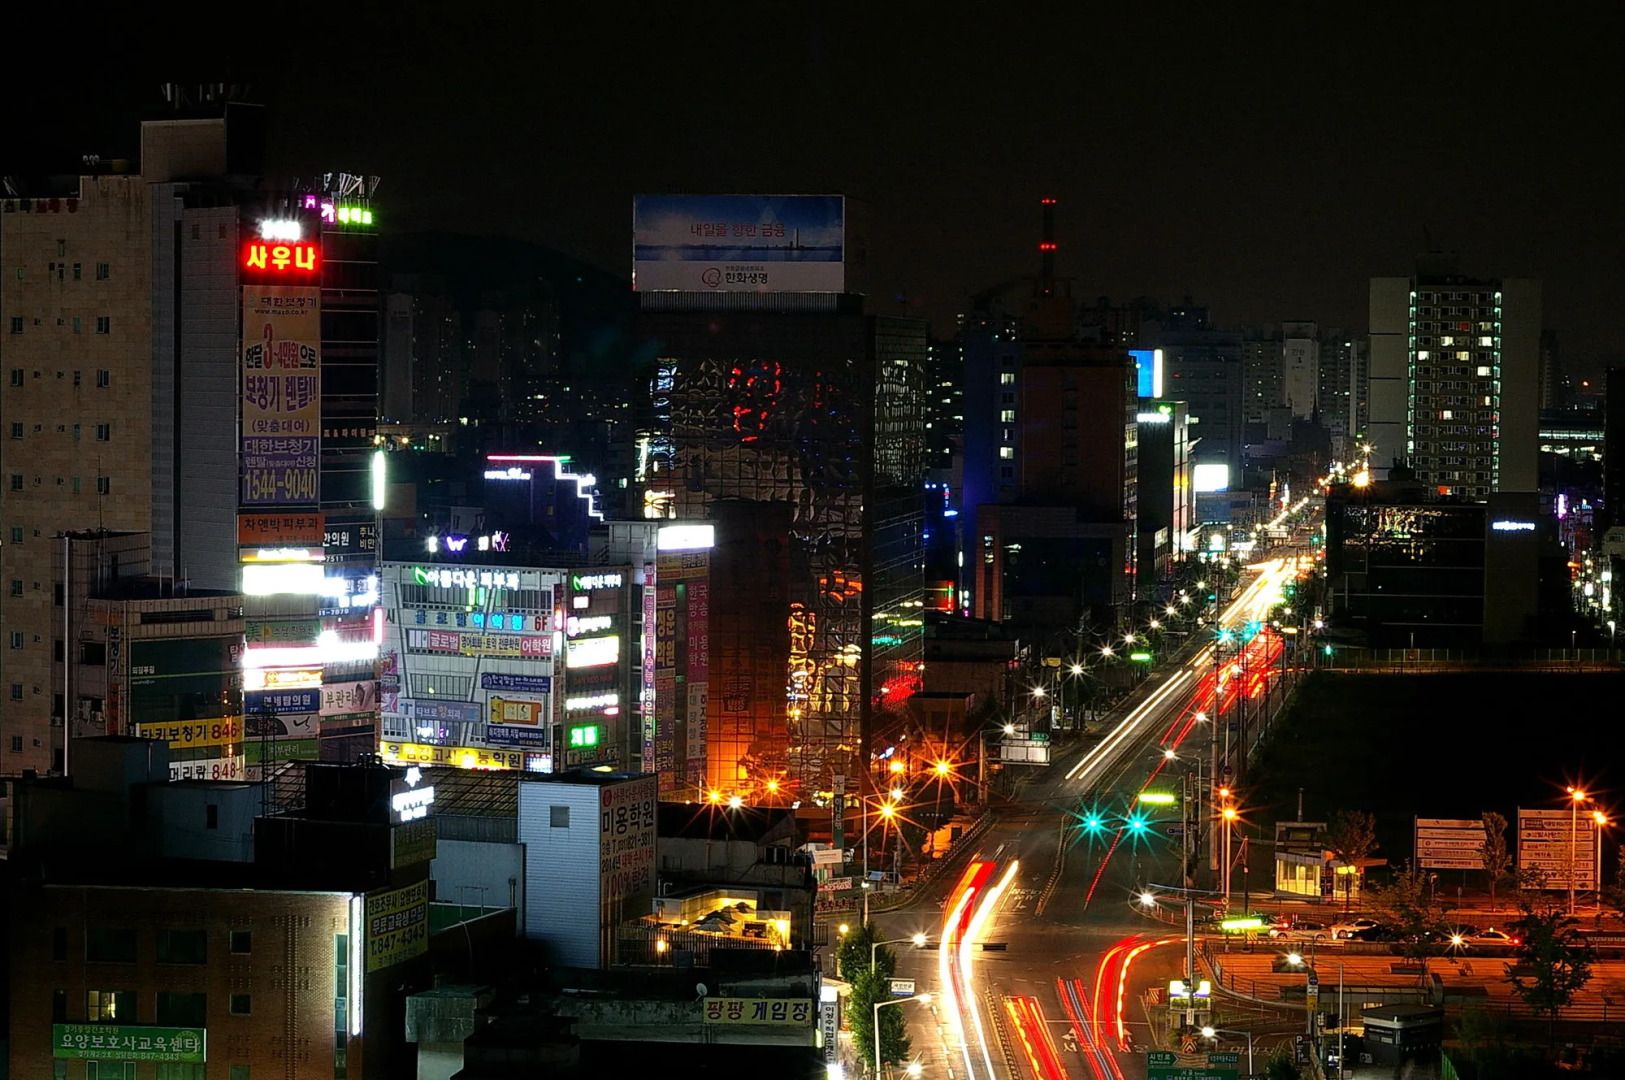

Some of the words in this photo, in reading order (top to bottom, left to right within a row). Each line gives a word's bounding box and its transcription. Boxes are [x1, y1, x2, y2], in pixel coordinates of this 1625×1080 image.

[690, 224, 728, 237] 내일을
[732, 224, 757, 237] 향한
[761, 224, 786, 237] 금융
[247, 245, 316, 270] 사우나
[725, 272, 768, 285] 한화생명
[261, 297, 317, 308] 대한보청기
[245, 376, 280, 412] 보청기
[285, 376, 317, 412] 렌탈!!
[252, 419, 310, 433] (맞춤대여)
[244, 438, 317, 455] 대한보청기
[244, 469, 317, 500] 1544-9040
[534, 616, 548, 631] 6F
[430, 632, 460, 650] 글로벌
[522, 638, 551, 653] 어학원
[602, 799, 654, 836] 미용학원
[372, 912, 410, 936] 무료교육생
[706, 1000, 745, 1021] 팡팡
[751, 1000, 810, 1022] 게임장
